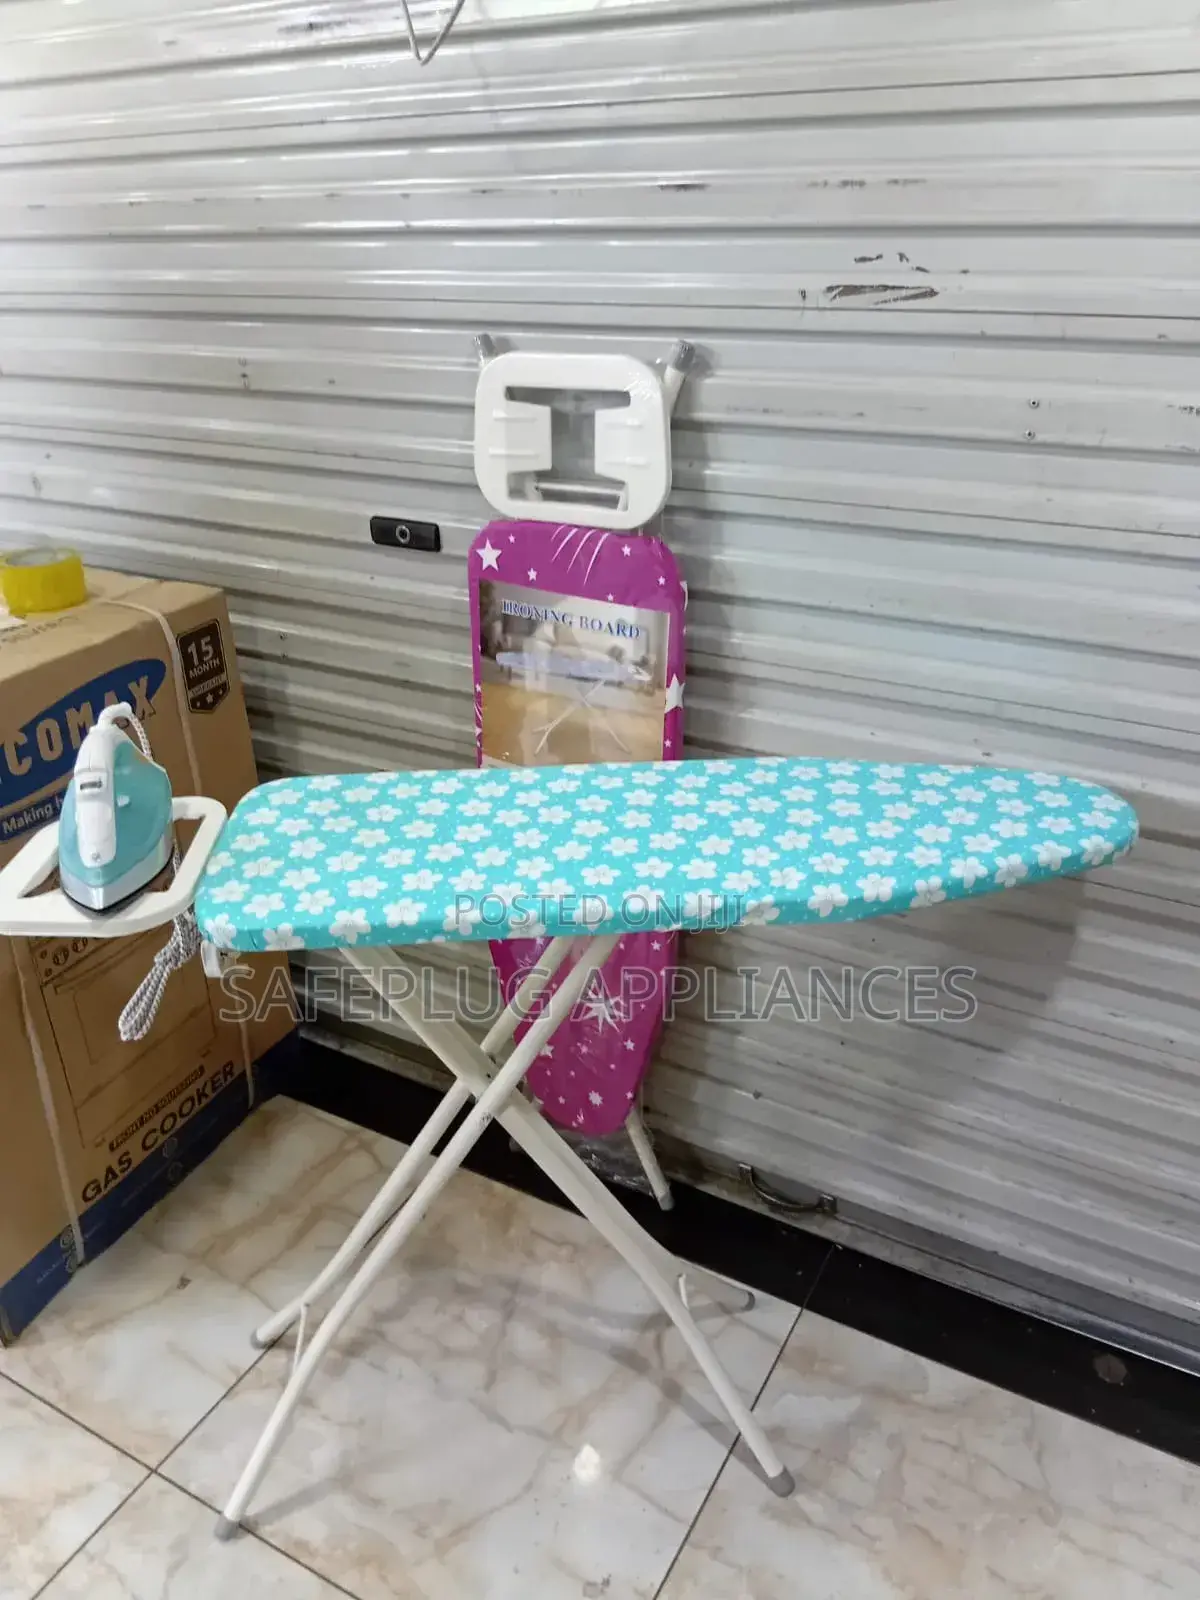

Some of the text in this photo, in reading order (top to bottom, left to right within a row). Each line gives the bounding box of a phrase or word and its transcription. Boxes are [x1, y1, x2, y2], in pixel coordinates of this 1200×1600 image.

[501, 598, 641, 639] IRONING BOARD
[187, 635, 214, 667] 15
[189, 657, 221, 679] MONTH
[2, 804, 54, 834] Making
[81, 1150, 133, 1203] GAS
[141, 1059, 236, 1152] COOKER
